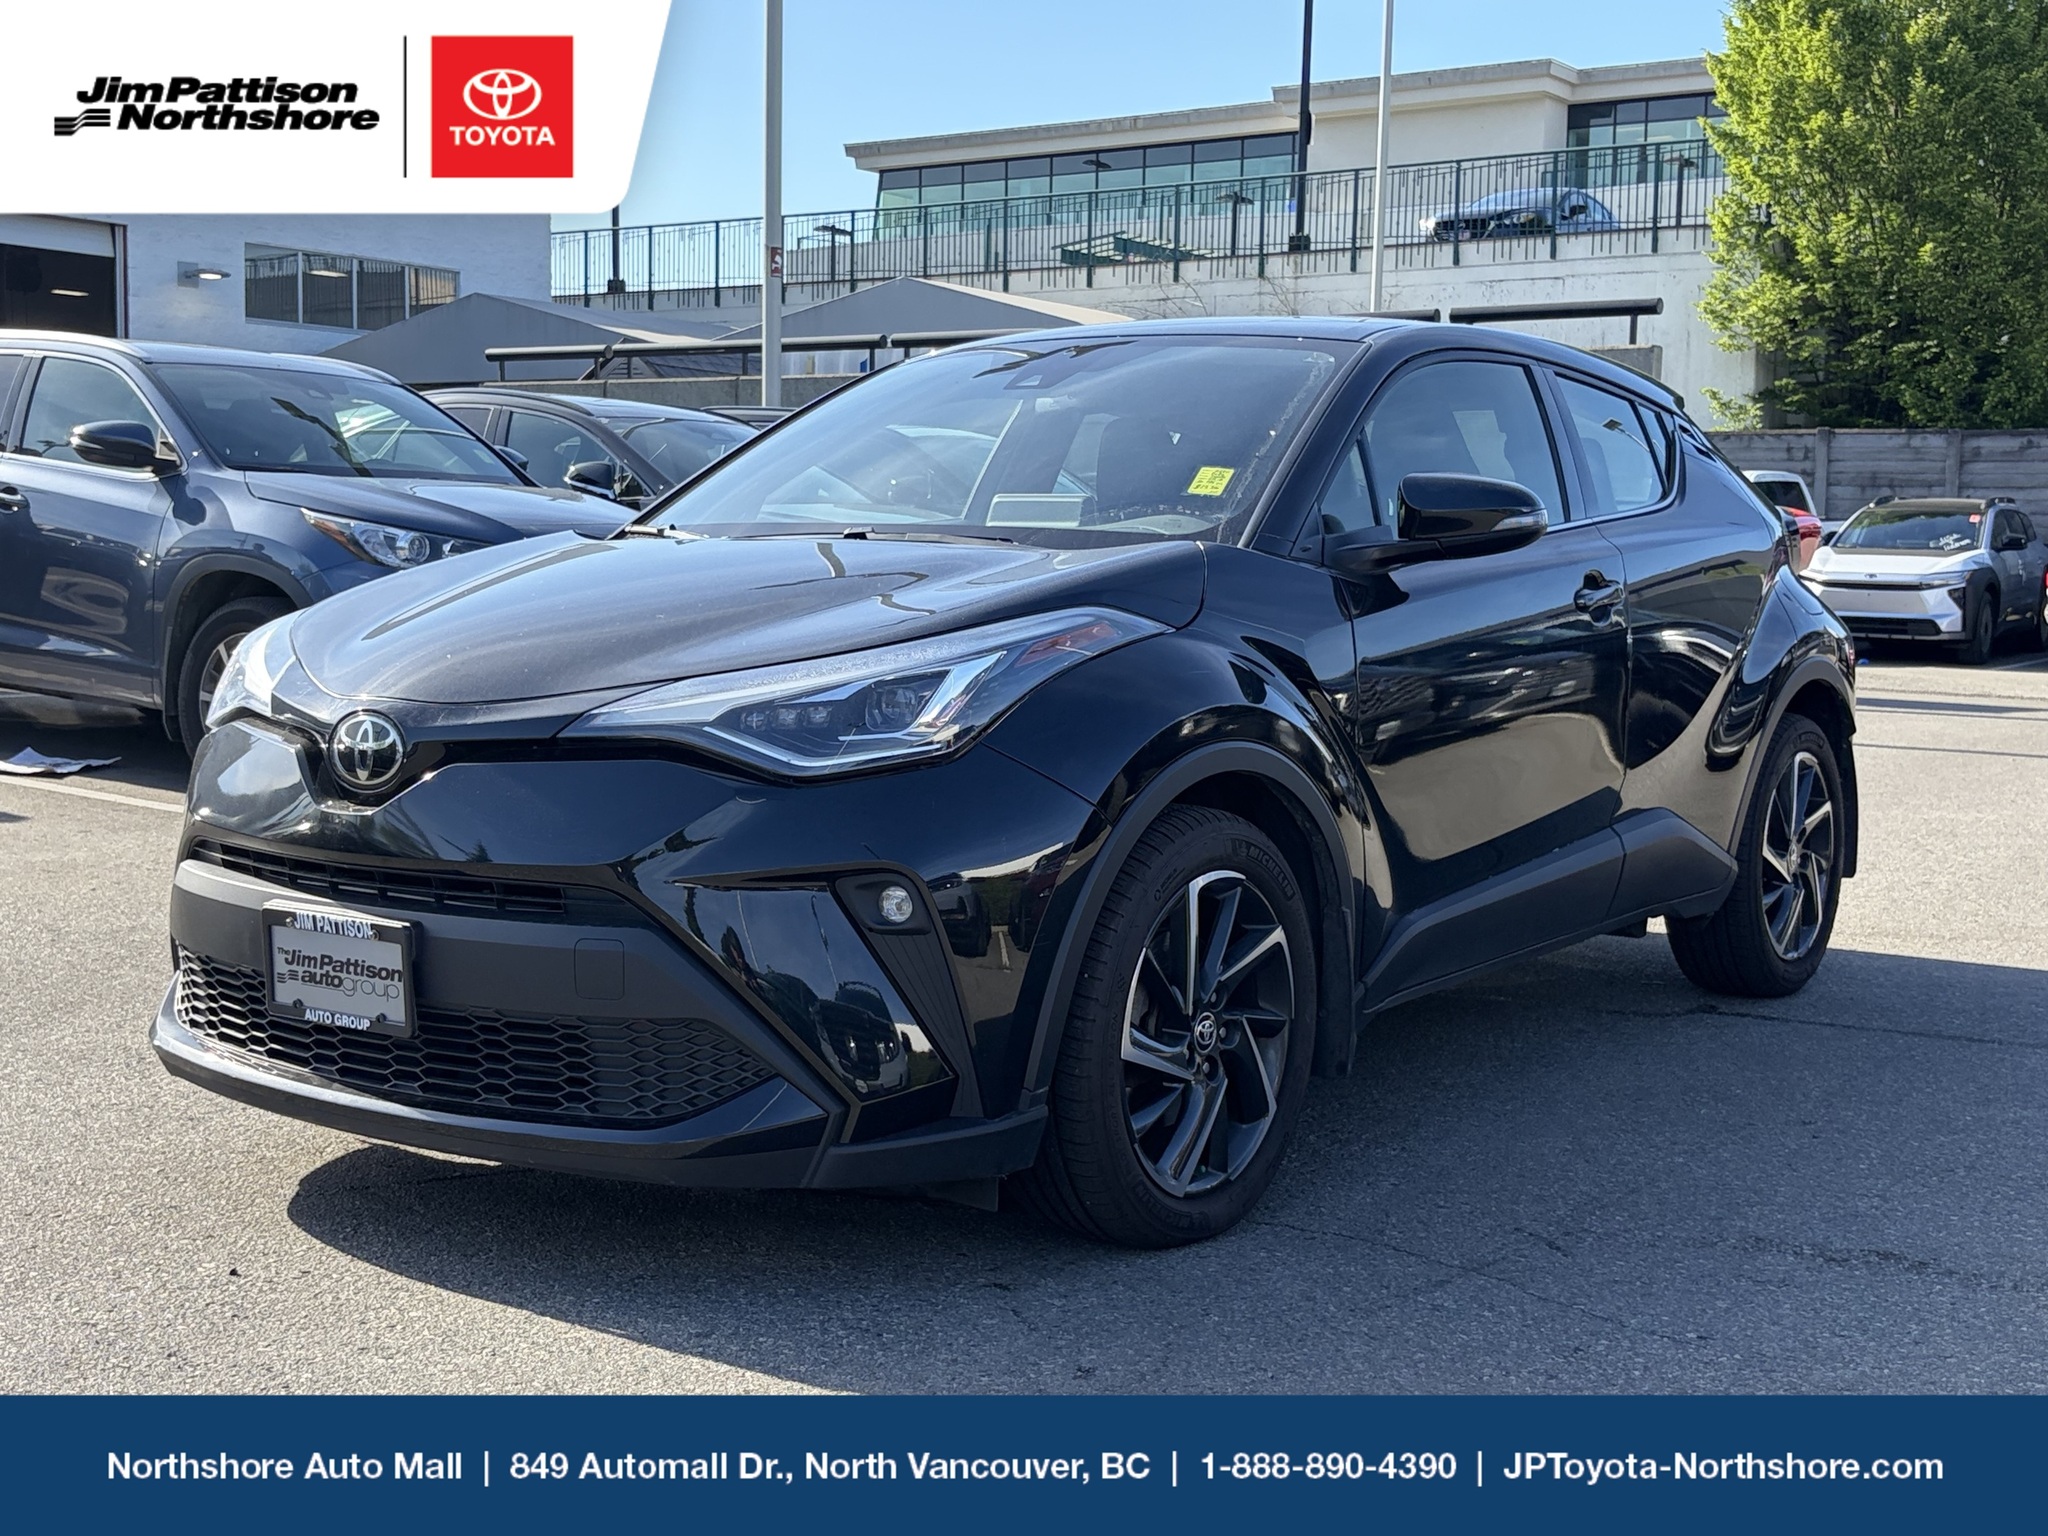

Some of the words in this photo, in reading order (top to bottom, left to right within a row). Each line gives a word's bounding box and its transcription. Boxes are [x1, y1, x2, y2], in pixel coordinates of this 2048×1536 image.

[1246, 843, 1295, 898] MICHELIN
[293, 912, 313, 931] JIM
[316, 915, 373, 939] PATTISON
[277, 946, 291, 956] The
[304, 1009, 332, 1025] AUTO
[334, 1013, 371, 1031] GROUP
